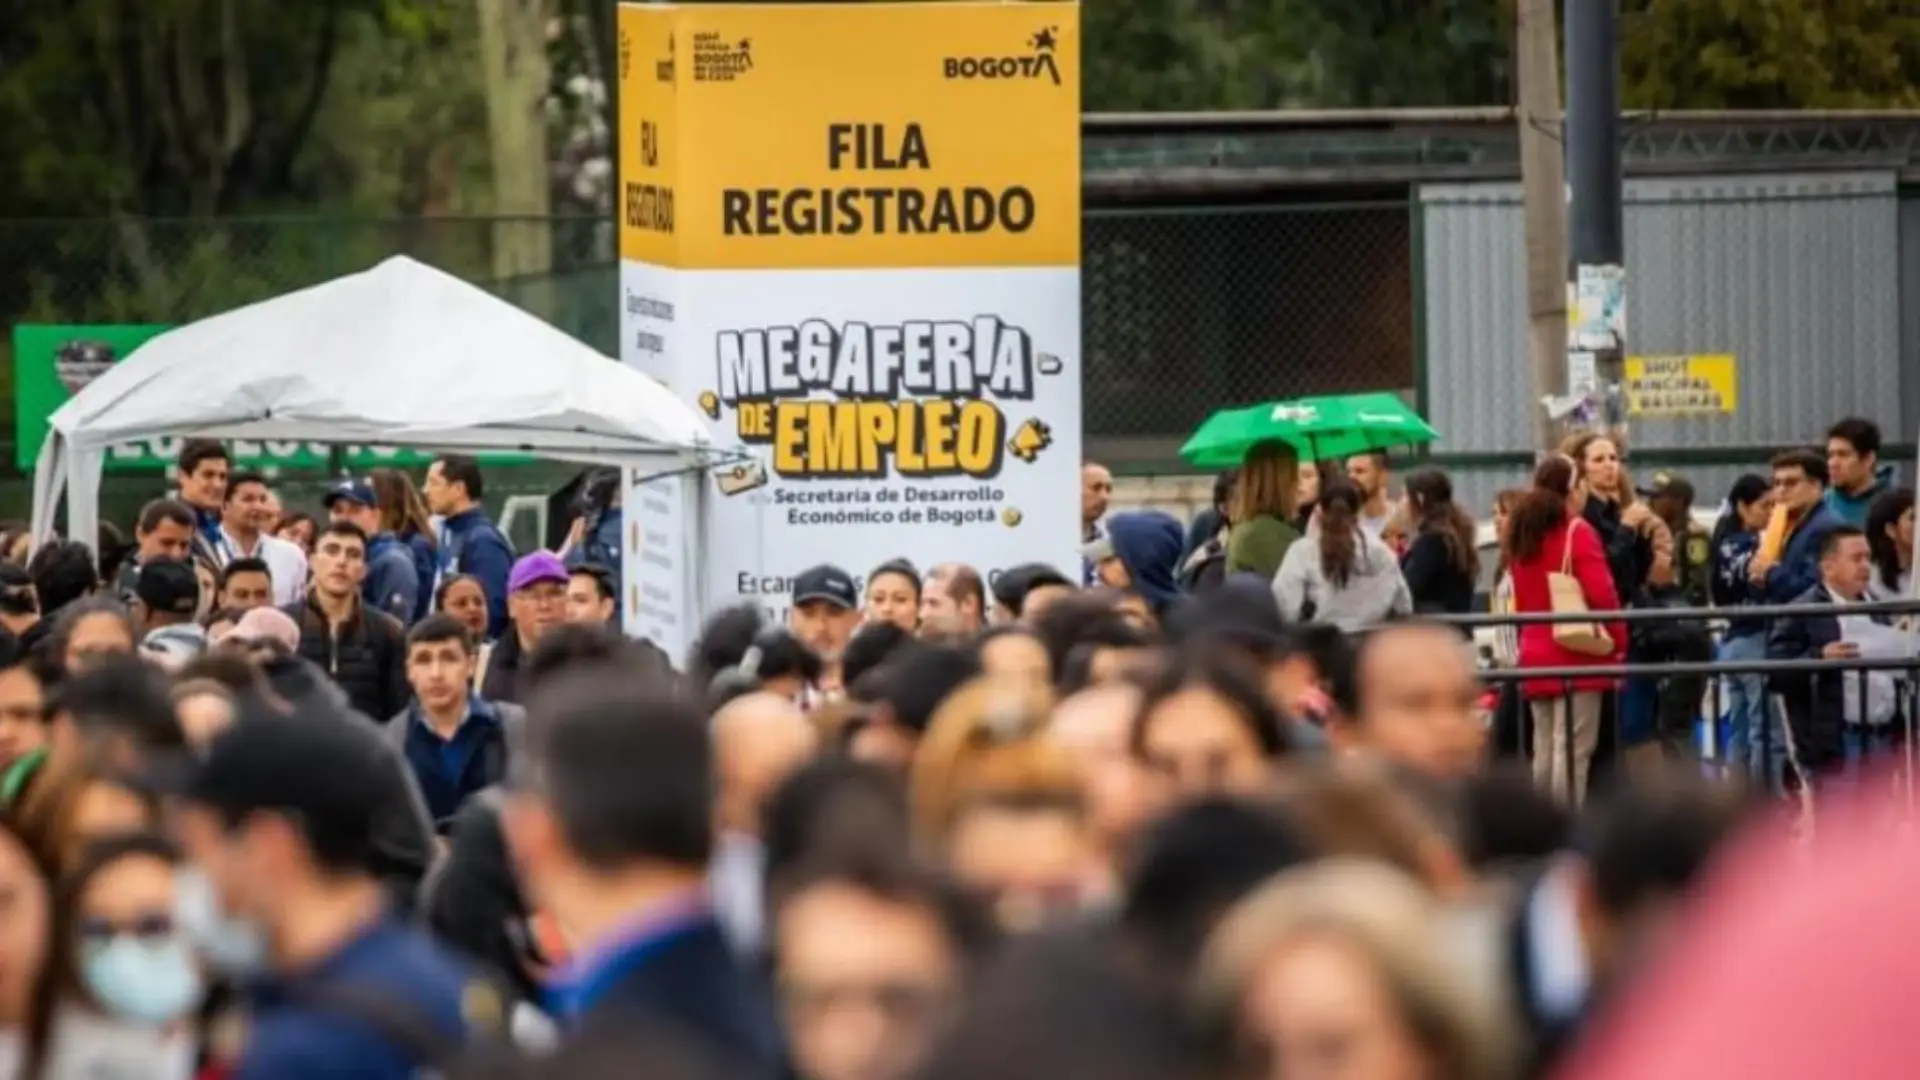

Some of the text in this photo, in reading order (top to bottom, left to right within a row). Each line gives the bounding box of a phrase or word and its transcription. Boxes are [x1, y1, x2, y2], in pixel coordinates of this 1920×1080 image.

[828, 124, 930, 170] FILA
[722, 187, 1036, 236] REGISTRADO
[716, 315, 1034, 401] MEGAFERIA
[738, 397, 1006, 478] DE EMPLEO
[787, 507, 996, 525] Económico de Bogotá
[876, 488, 899, 502] de
[904, 486, 1005, 502] Desarrollo
